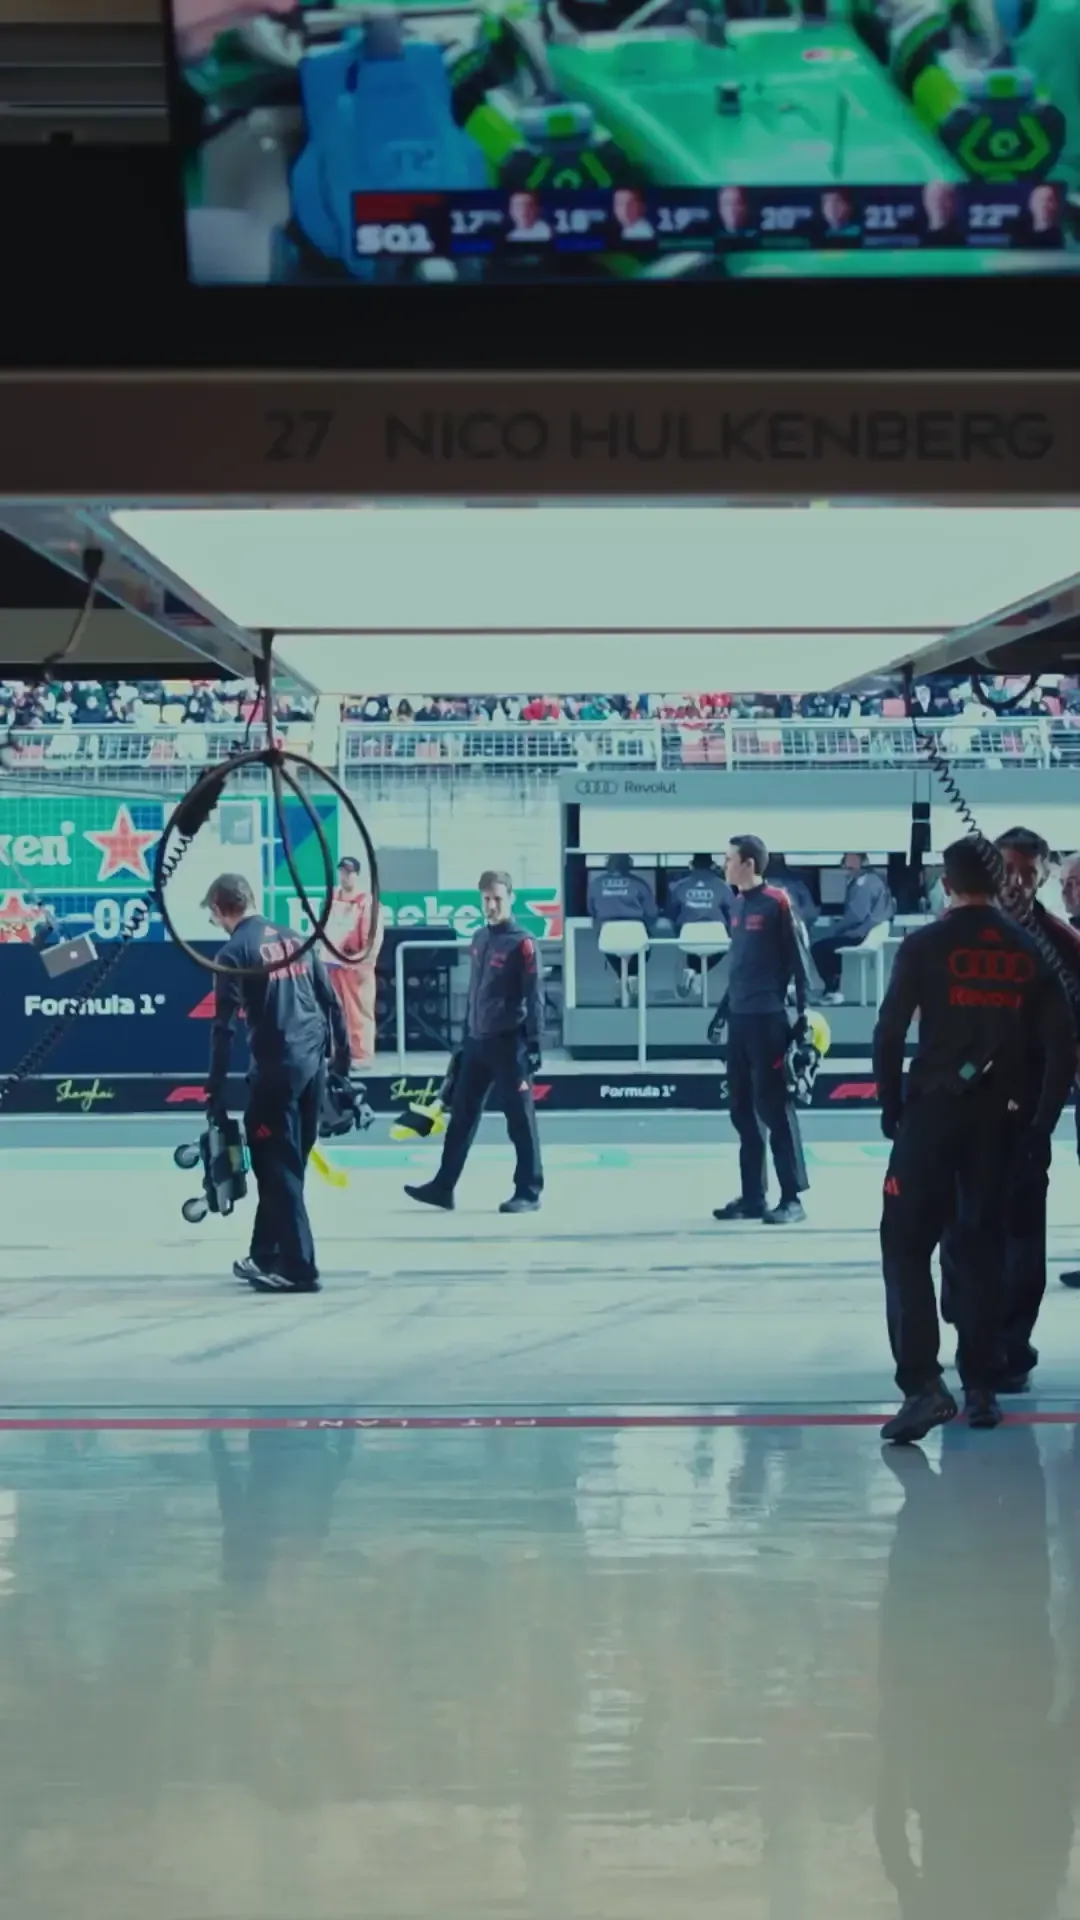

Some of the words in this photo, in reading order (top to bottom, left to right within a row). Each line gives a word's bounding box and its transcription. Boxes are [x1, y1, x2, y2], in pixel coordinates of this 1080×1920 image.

[263, 410, 334, 460] 27
[385, 409, 549, 460] NICO
[569, 410, 1053, 461] HULKENBERG
[624, 780, 677, 794] Revolut
[24, 994, 135, 1016] Formula
[56, 1078, 114, 1111] Shanghai
[600, 1085, 660, 1098] Formula
